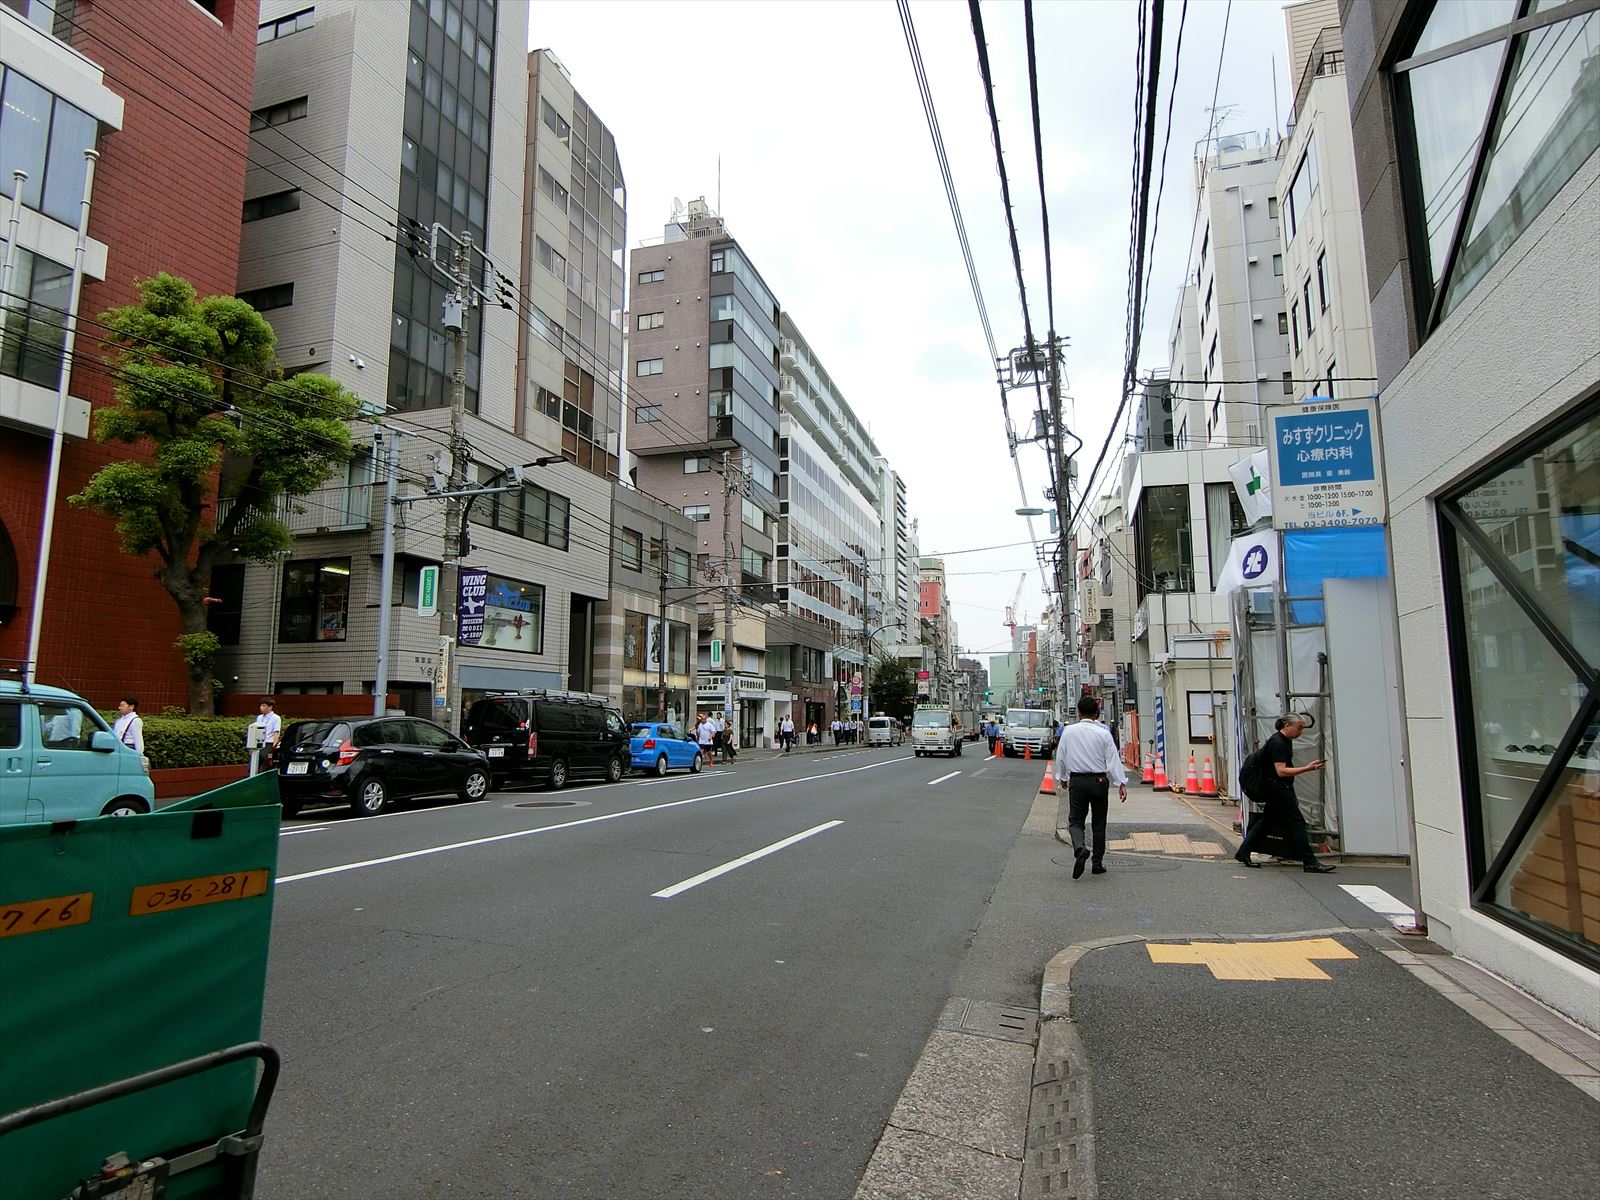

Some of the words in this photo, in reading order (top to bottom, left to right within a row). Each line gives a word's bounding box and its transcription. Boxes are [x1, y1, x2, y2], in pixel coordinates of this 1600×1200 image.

[1282, 421, 1364, 446] みすずクリニック
[1296, 445, 1353, 463] 心療内科
[1312, 484, 1342, 492] 診療時間
[1307, 510, 1334, 519] 当ビル
[1303, 516, 1378, 529] 03-3400-7070
[462, 574, 487, 586] WING
[462, 586, 486, 597] CLUB
[147, 875, 249, 908] 036-281
